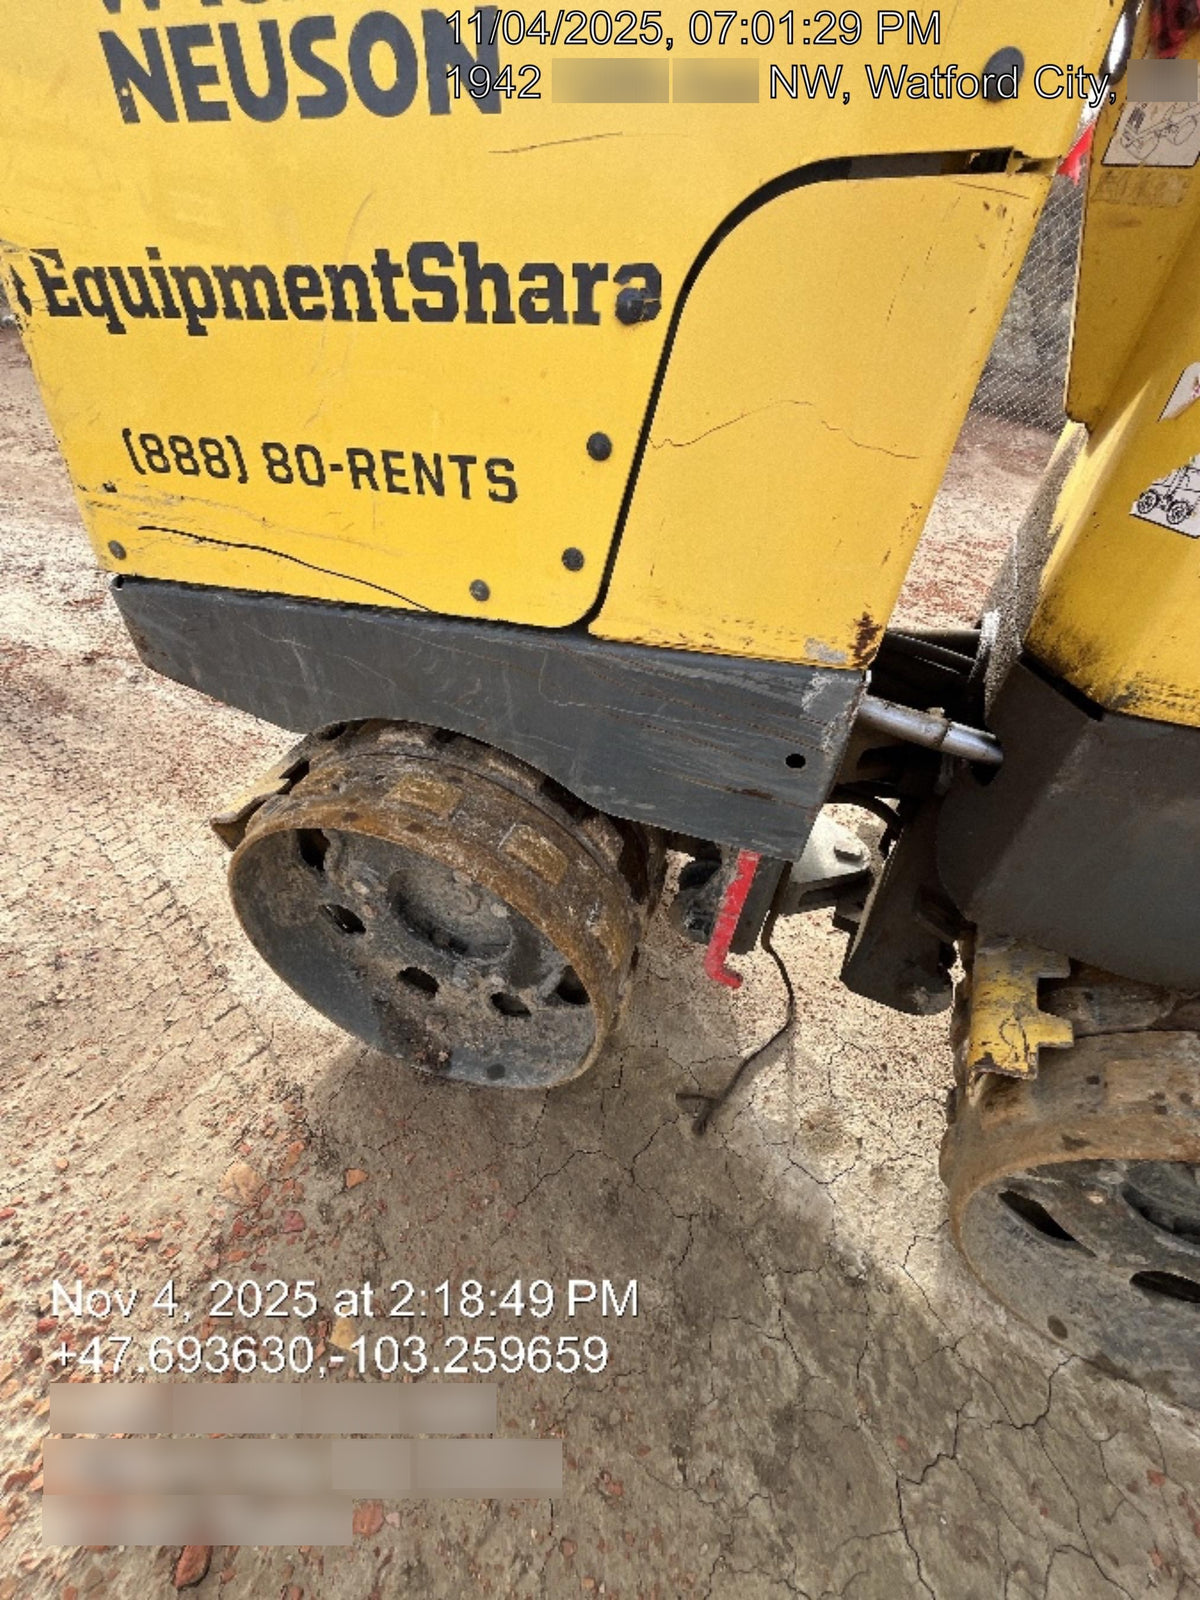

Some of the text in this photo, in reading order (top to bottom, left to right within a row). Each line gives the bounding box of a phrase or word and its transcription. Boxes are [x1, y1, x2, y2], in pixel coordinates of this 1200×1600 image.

[99, 6, 502, 124] NEUSON
[121, 428, 518, 504] (888) 80-RENTS
